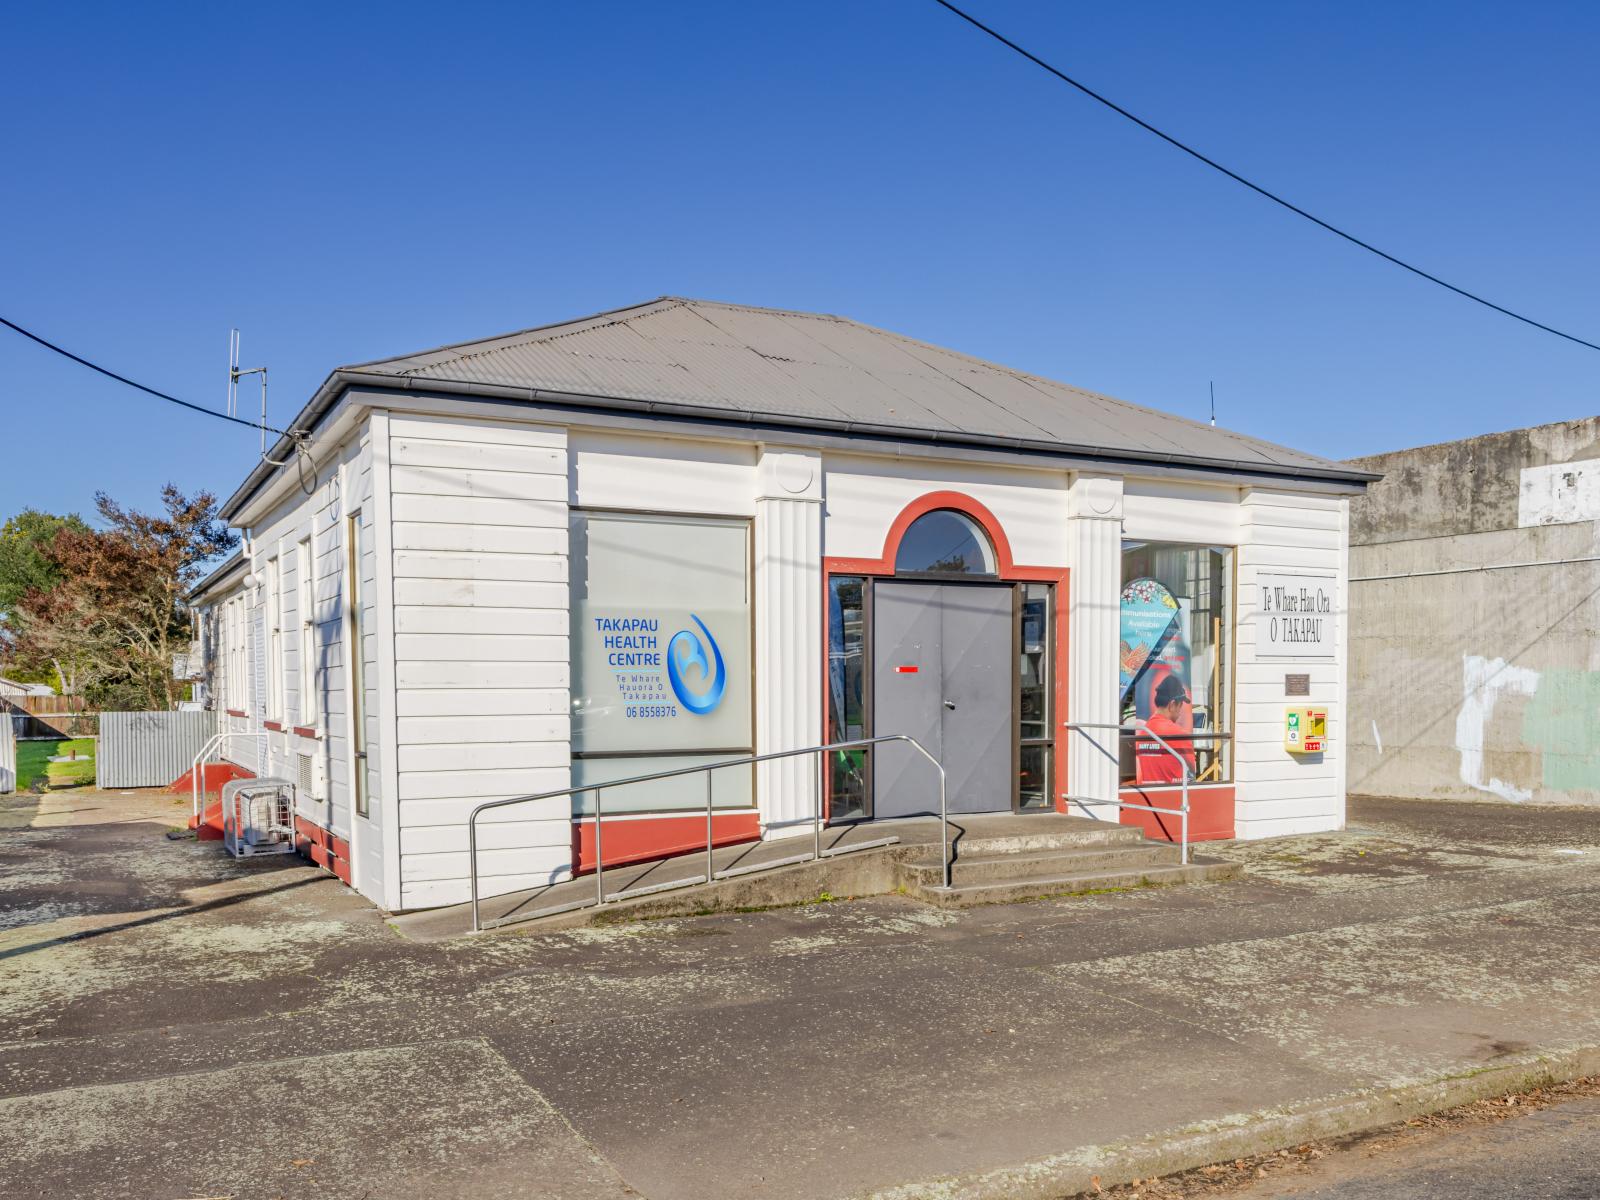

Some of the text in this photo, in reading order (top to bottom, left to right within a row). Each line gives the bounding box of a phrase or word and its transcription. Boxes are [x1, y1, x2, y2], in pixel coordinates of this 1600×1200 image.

[1262, 586, 1330, 613] Te Whare Hau Ora
[594, 618, 658, 632] TAKAPAU
[1270, 616, 1323, 643] O TAKAPAU
[604, 635, 657, 649] HEALTH
[608, 652, 661, 666] CENTRE
[616, 674, 660, 683] Te Whare
[619, 683, 663, 692] Hauora O
[622, 692, 667, 701] Takapau
[626, 705, 677, 718] 06 8558376
